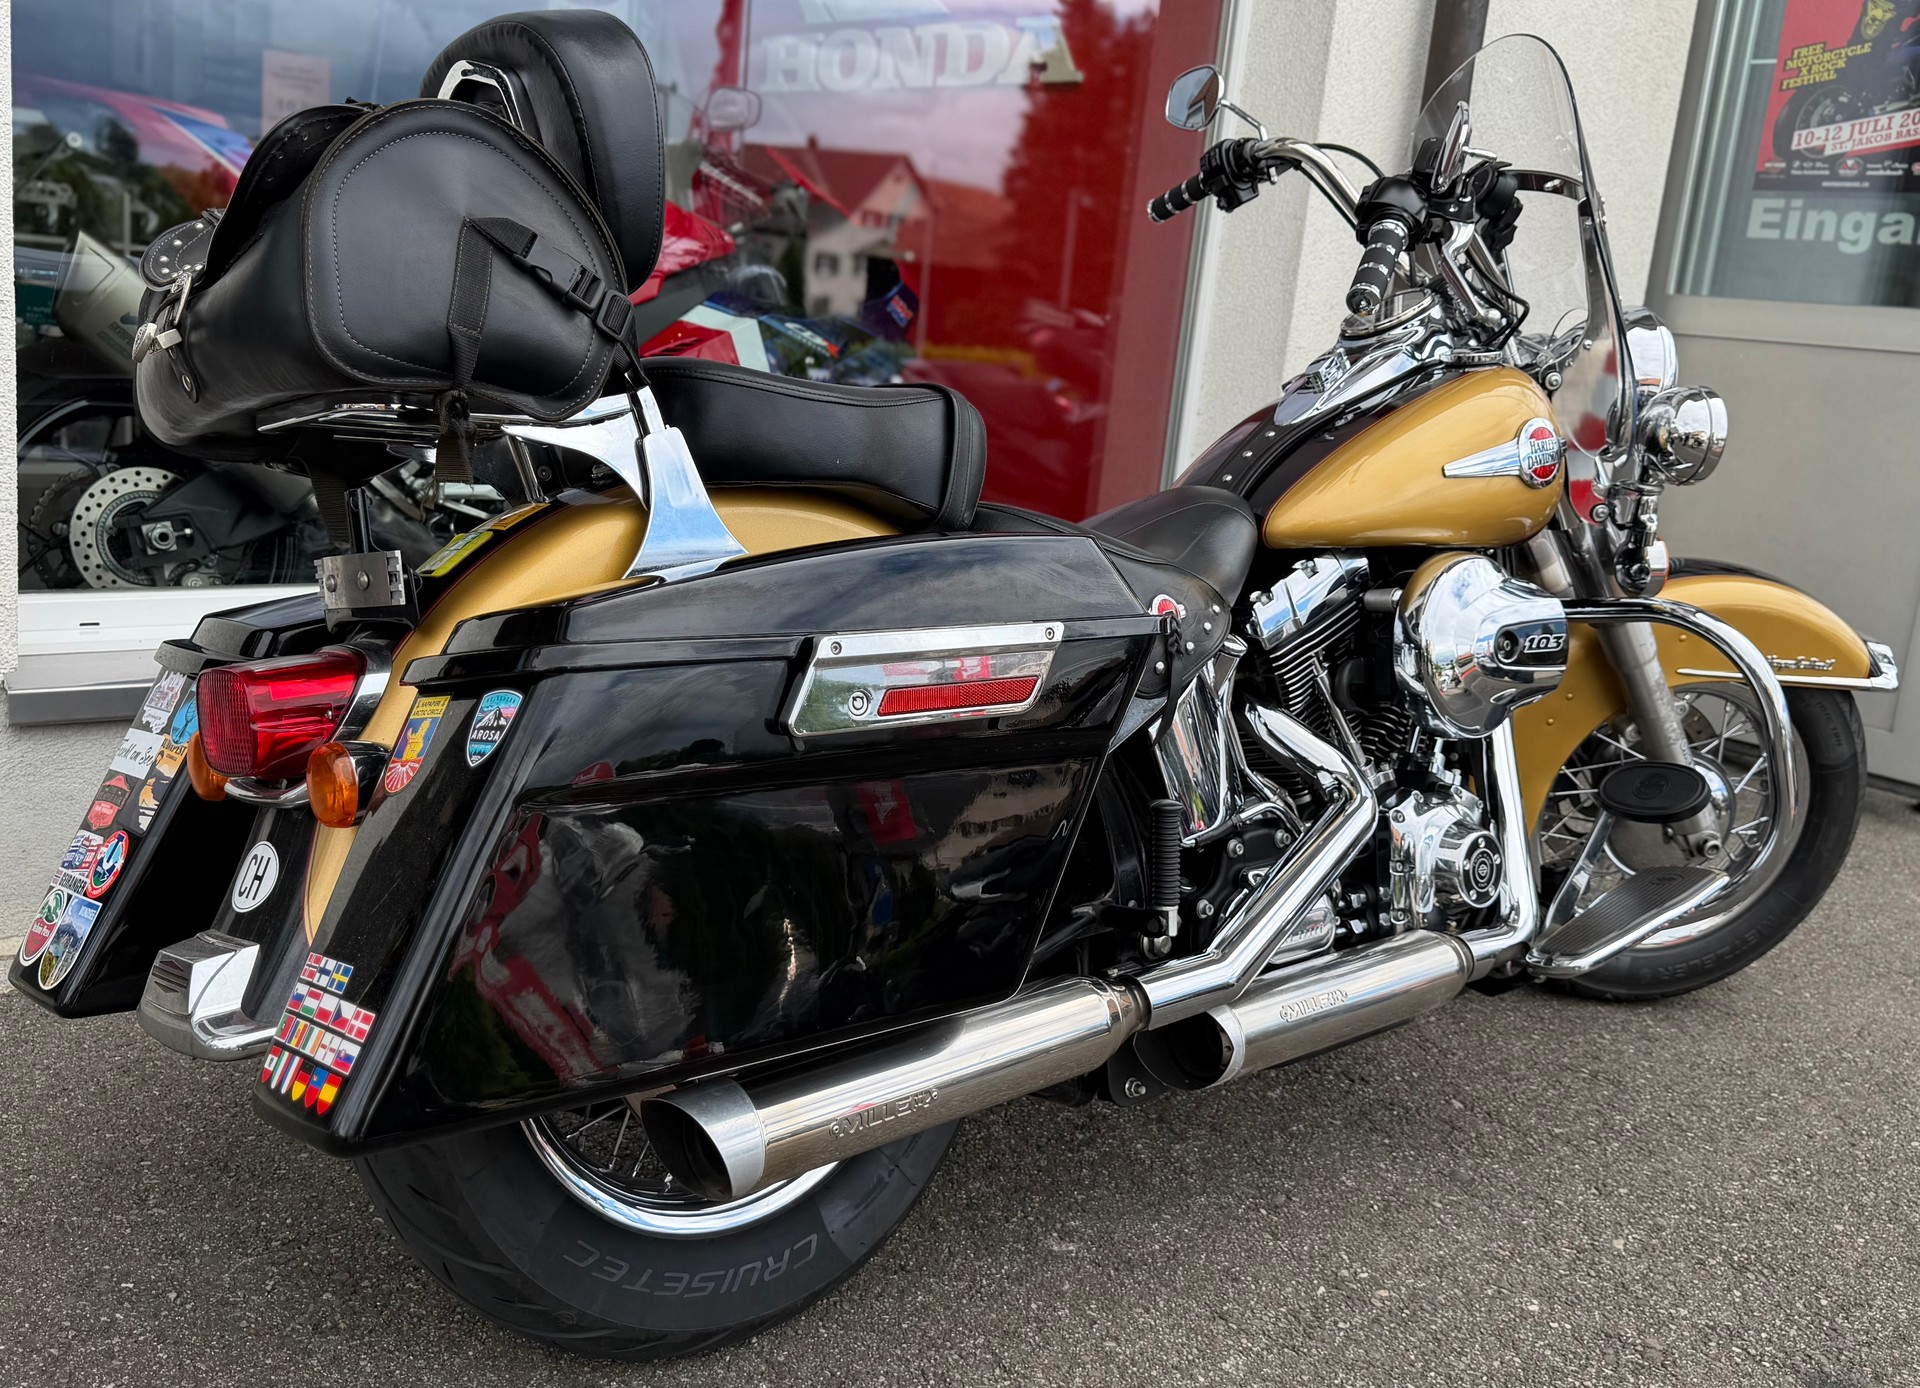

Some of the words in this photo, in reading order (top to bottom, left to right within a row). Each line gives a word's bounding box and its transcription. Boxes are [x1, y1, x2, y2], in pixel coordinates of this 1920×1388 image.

[760, 16, 1084, 92] HONDA
[1785, 42, 1872, 71] MOTORCYCLE
[1792, 43, 1826, 58] FREE
[1799, 64, 1810, 76] X
[1812, 57, 1847, 74] ROCK
[1781, 70, 1837, 90] FESTIVAL
[1794, 124, 1843, 149] 10-12
[1846, 115, 1895, 145] JULI
[1831, 140, 1850, 152] ST.
[1851, 132, 1893, 149] JAKOB
[1747, 198, 1920, 255] Einga
[1522, 633, 1567, 653] 103
[411, 708, 427, 717] ARCTIC
[427, 708, 443, 716] CIRCLE
[471, 730, 500, 741] AROSA
[59, 871, 88, 897] GEIRANGER
[237, 853, 272, 901] CH
[836, 1089, 931, 1137] MILLER
[562, 1232, 818, 1299] CRUISETEC
